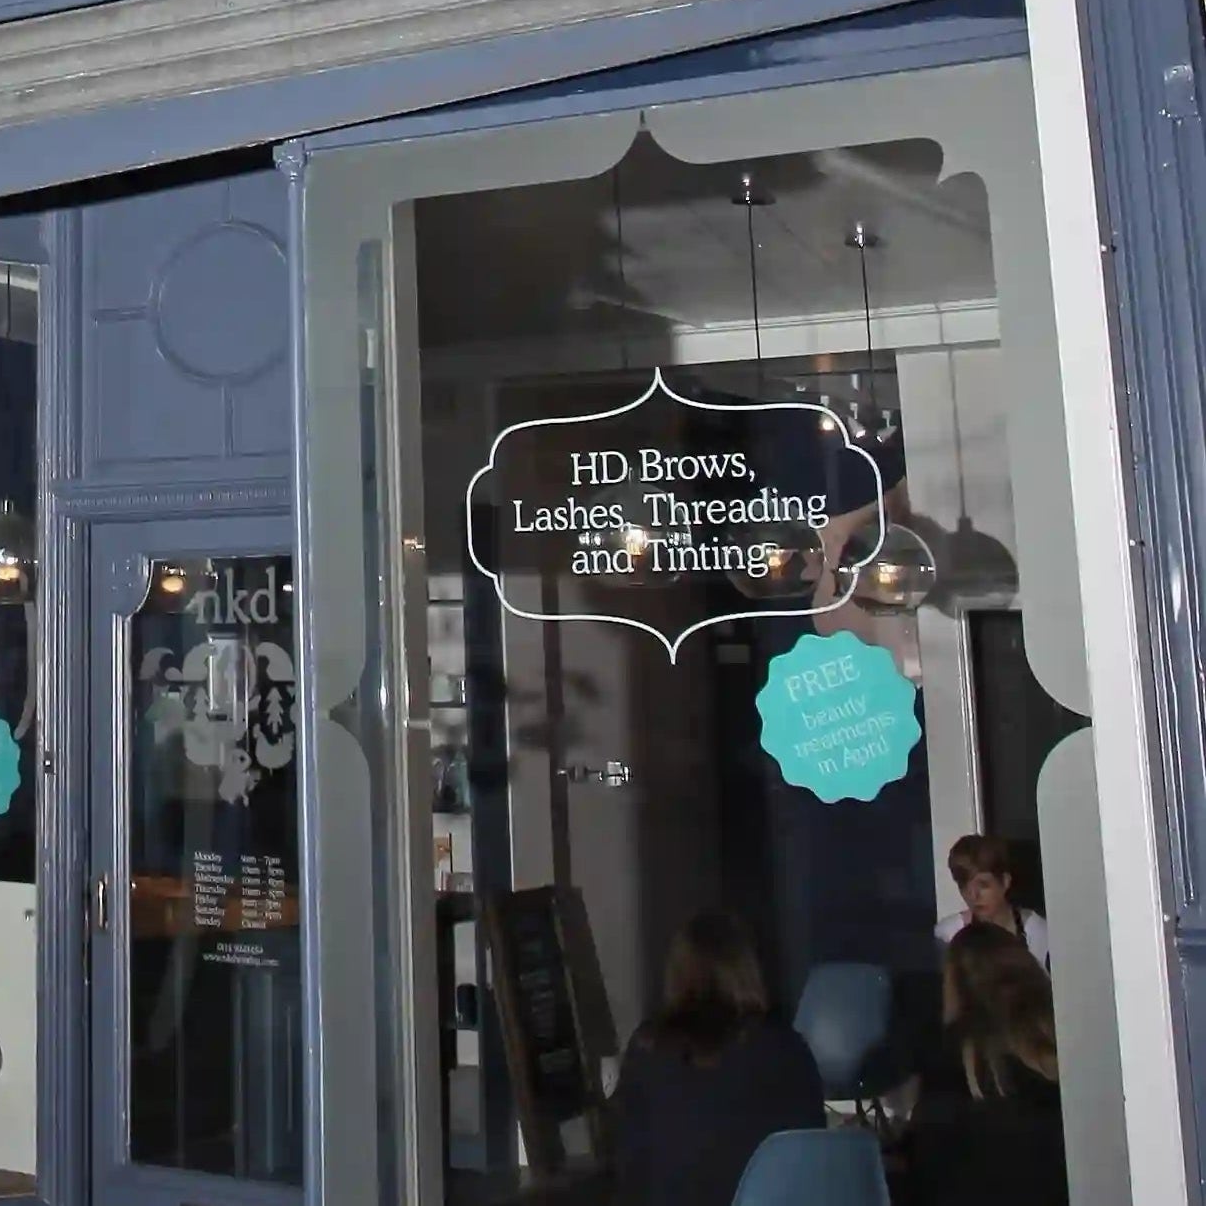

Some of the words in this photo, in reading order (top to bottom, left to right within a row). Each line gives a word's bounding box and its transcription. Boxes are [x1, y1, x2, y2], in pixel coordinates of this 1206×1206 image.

[570, 451, 629, 486] HD
[639, 448, 757, 484] Brows,
[642, 488, 830, 530] Threading
[571, 542, 634, 576] and
[646, 536, 771, 579] Tinting
[195, 564, 279, 625] nkd
[785, 654, 861, 703] FREE
